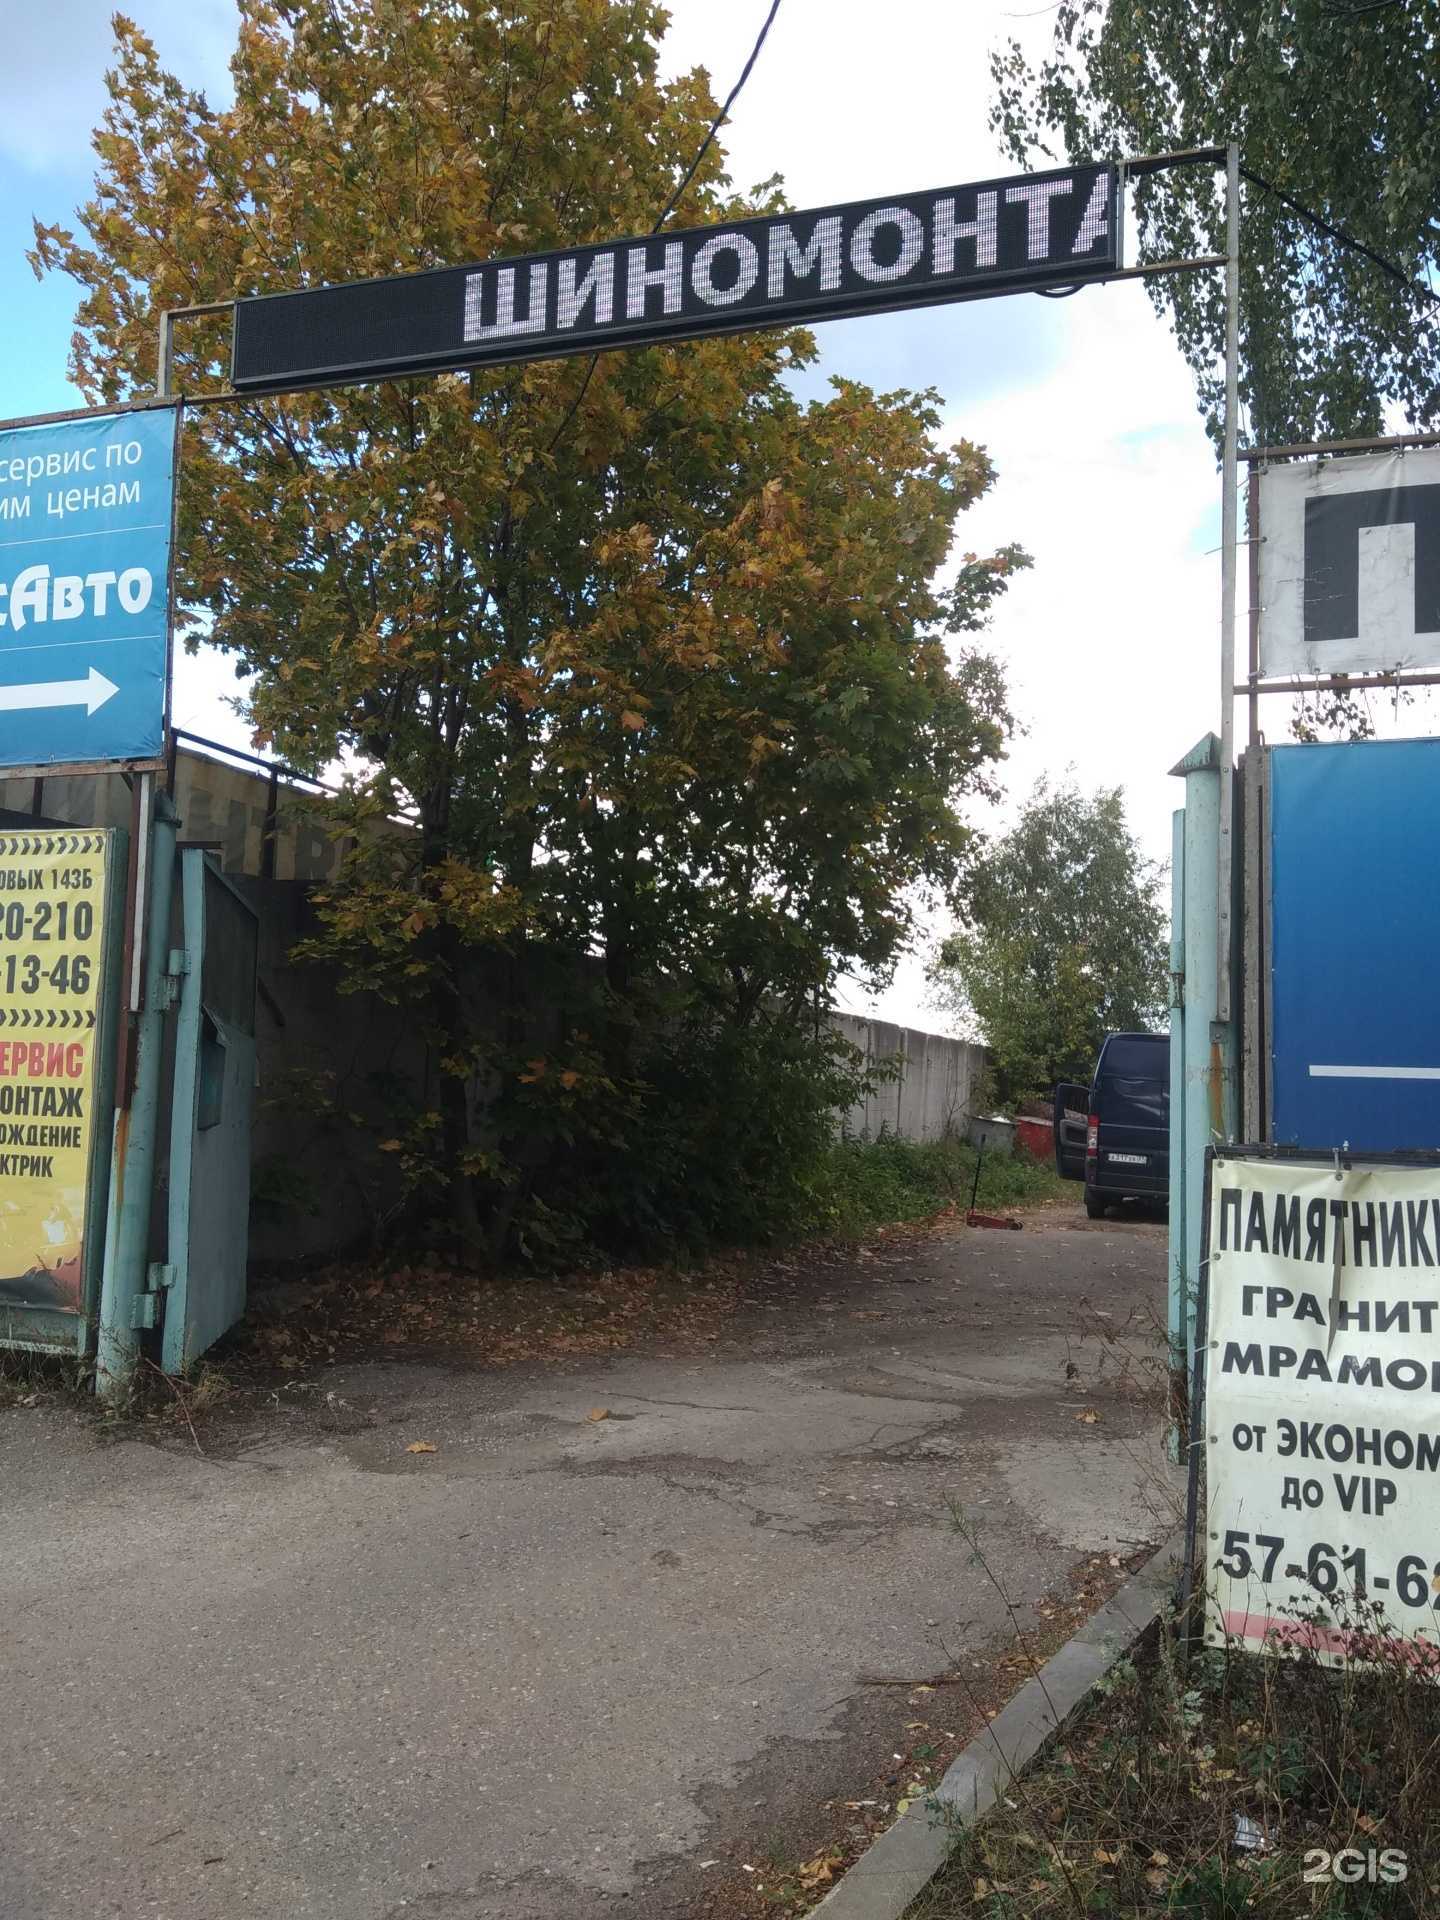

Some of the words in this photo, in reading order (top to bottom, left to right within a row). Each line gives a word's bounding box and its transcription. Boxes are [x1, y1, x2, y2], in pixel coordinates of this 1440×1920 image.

[105, 441, 142, 468] по
[47, 480, 141, 519] ценам
[0, 901, 93, 941] 0-210
[0, 954, 91, 995] 13-46
[0, 1041, 84, 1078] ЕРВИС
[0, 1085, 84, 1118] ОНТАЖ
[1219, 1188, 1440, 1267] ПАМЯТНИК
[1242, 1285, 1439, 1334] ГРАНИТ
[1221, 1342, 1440, 1393] МРАМО
[1232, 1423, 1267, 1453] от
[1276, 1418, 1440, 1472] ЭКОНОМ
[1281, 1477, 1324, 1511] до
[1333, 1473, 1397, 1516] VIP
[1222, 1530, 1440, 1610] 57-61-6
